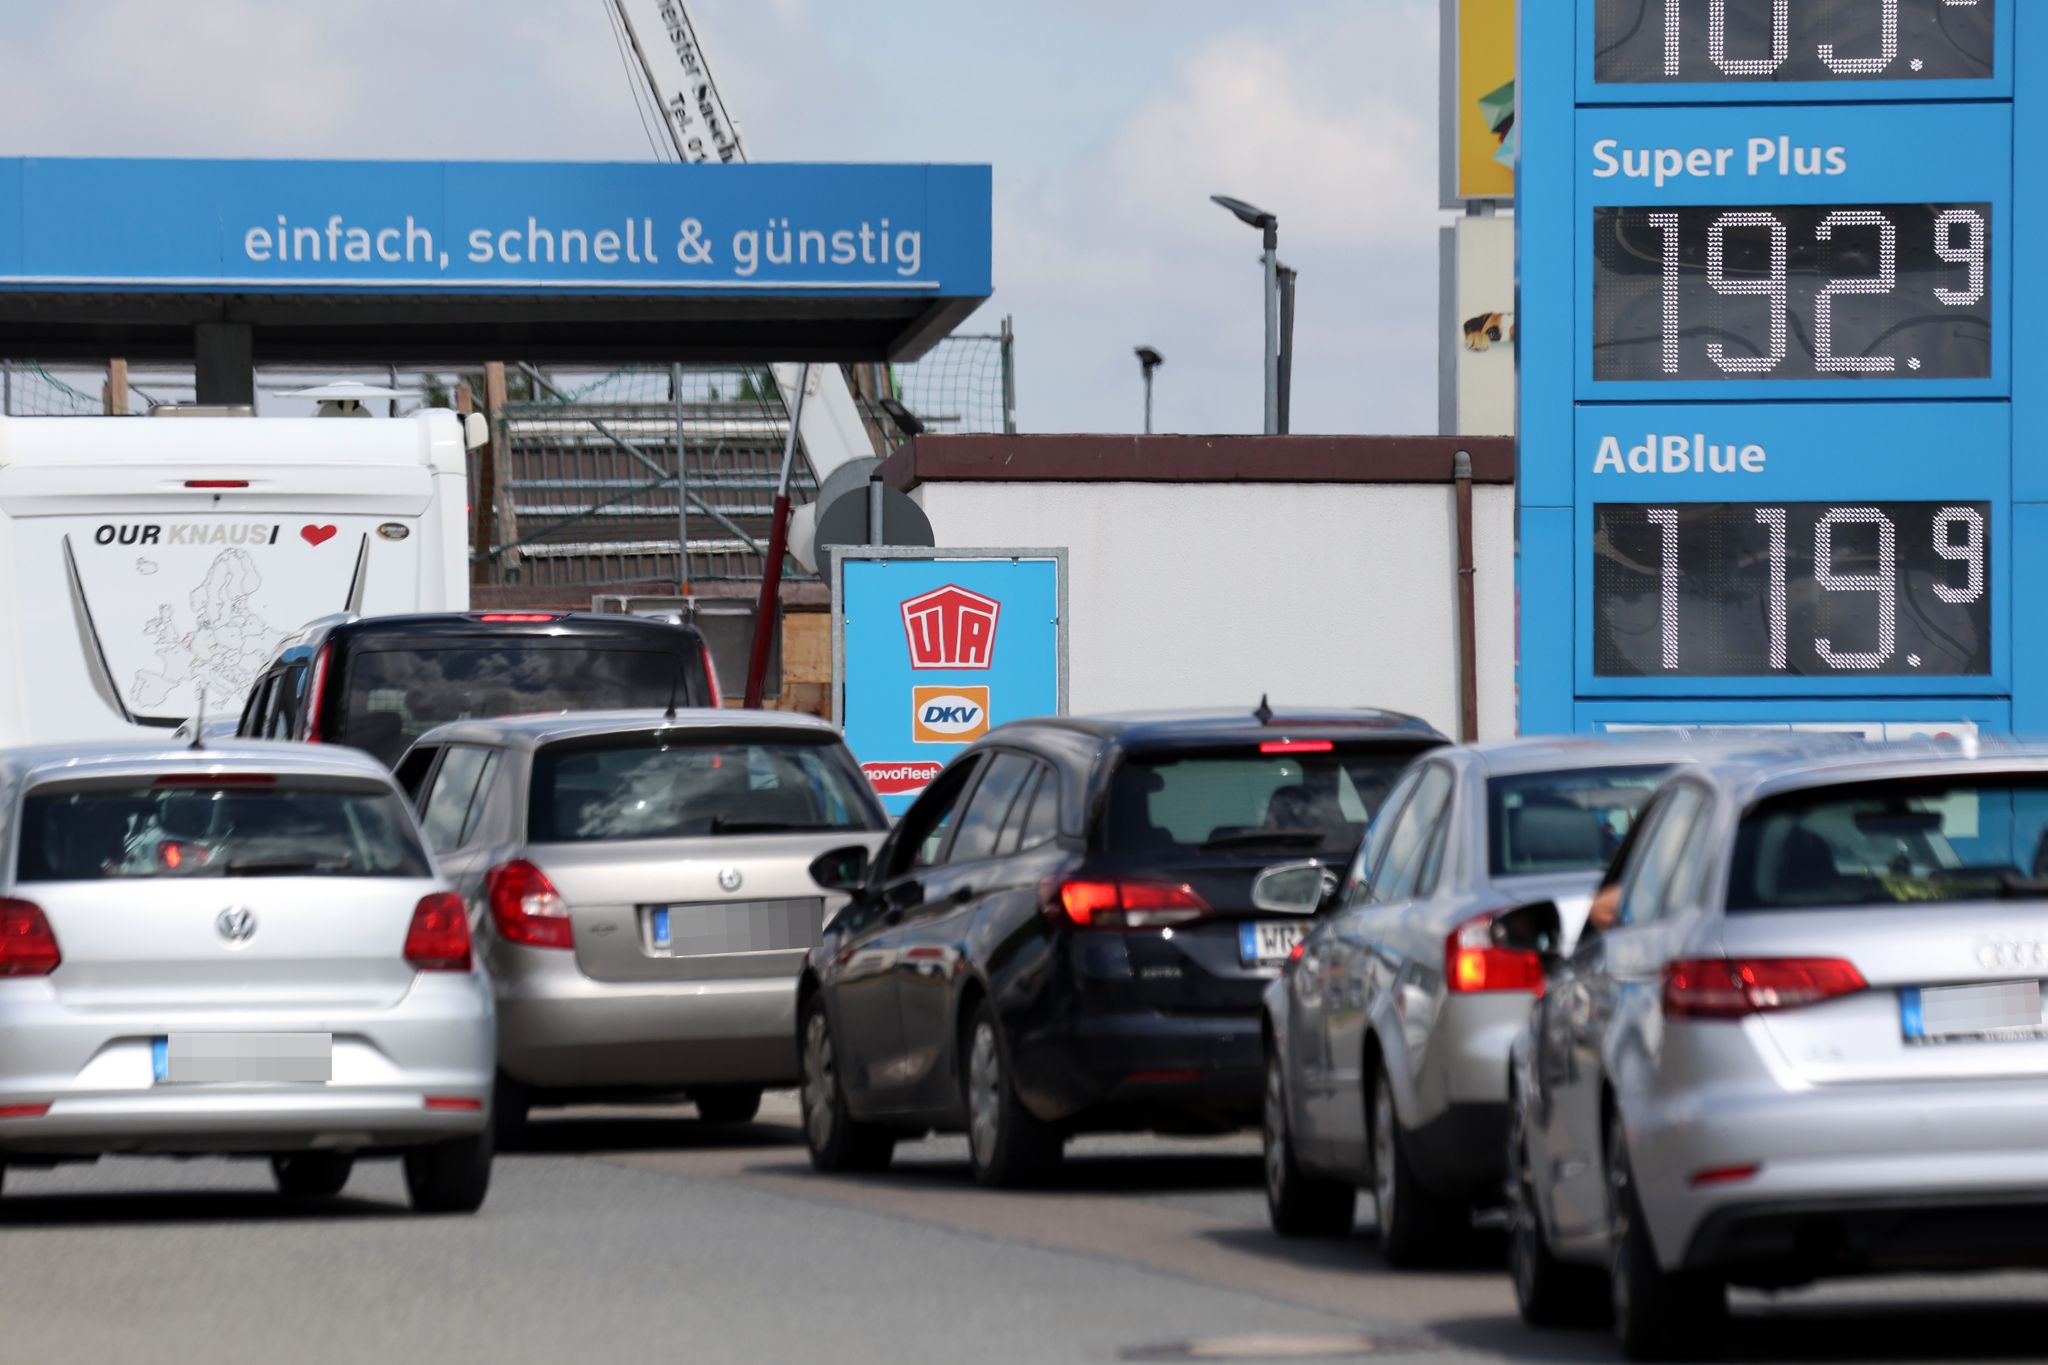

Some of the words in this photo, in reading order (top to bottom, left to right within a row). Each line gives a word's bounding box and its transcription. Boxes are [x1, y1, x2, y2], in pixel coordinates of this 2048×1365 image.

[668, 91, 694, 134] Tel.
[1592, 138, 1734, 187] Super
[1746, 135, 1848, 177] Plus
[244, 215, 450, 270] einfach,
[467, 216, 658, 264] schnell
[676, 217, 713, 265] &
[732, 218, 923, 277] günstig
[1592, 433, 1767, 475] AdBlue
[95, 524, 161, 546] OUR
[907, 588, 996, 665] UTA
[924, 705, 979, 724] DKV
